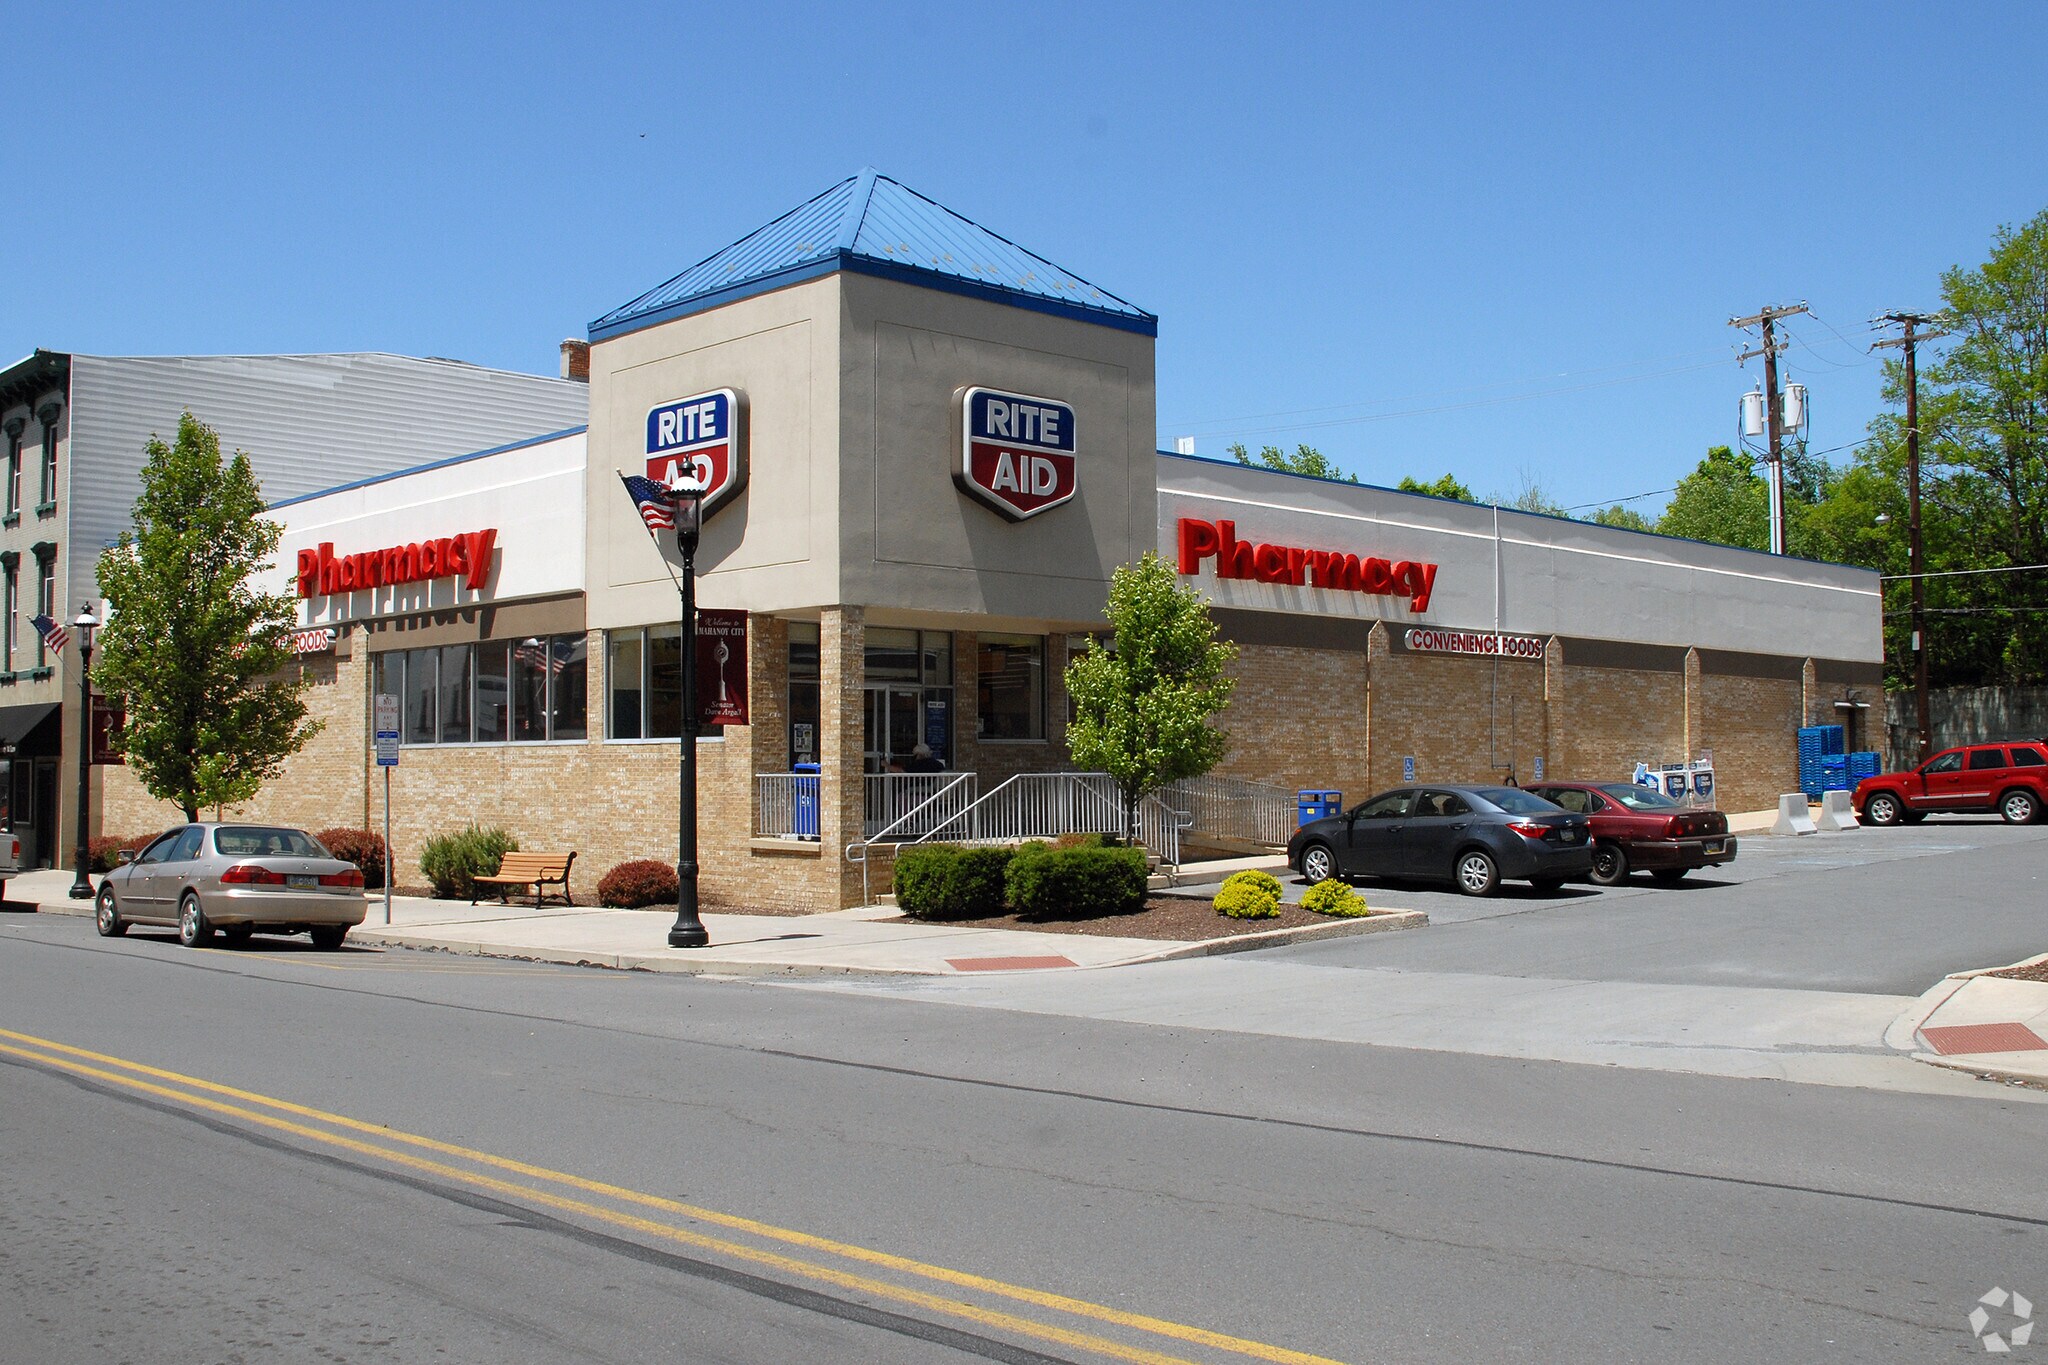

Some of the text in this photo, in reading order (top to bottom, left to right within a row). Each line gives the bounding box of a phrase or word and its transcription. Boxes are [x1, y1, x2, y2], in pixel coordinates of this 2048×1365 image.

[658, 400, 717, 447] RITE
[987, 399, 1060, 445] RITE
[663, 453, 714, 492] AD
[991, 451, 1058, 497] AID
[297, 528, 498, 599] Pharmacy
[1177, 517, 1439, 613] Pharmacy
[699, 627, 745, 636] MAHANOY CITY
[705, 618, 731, 627] Welcome
[1412, 630, 1542, 658] CONVENIENCE FOODS
[377, 706, 398, 714] PARKING
